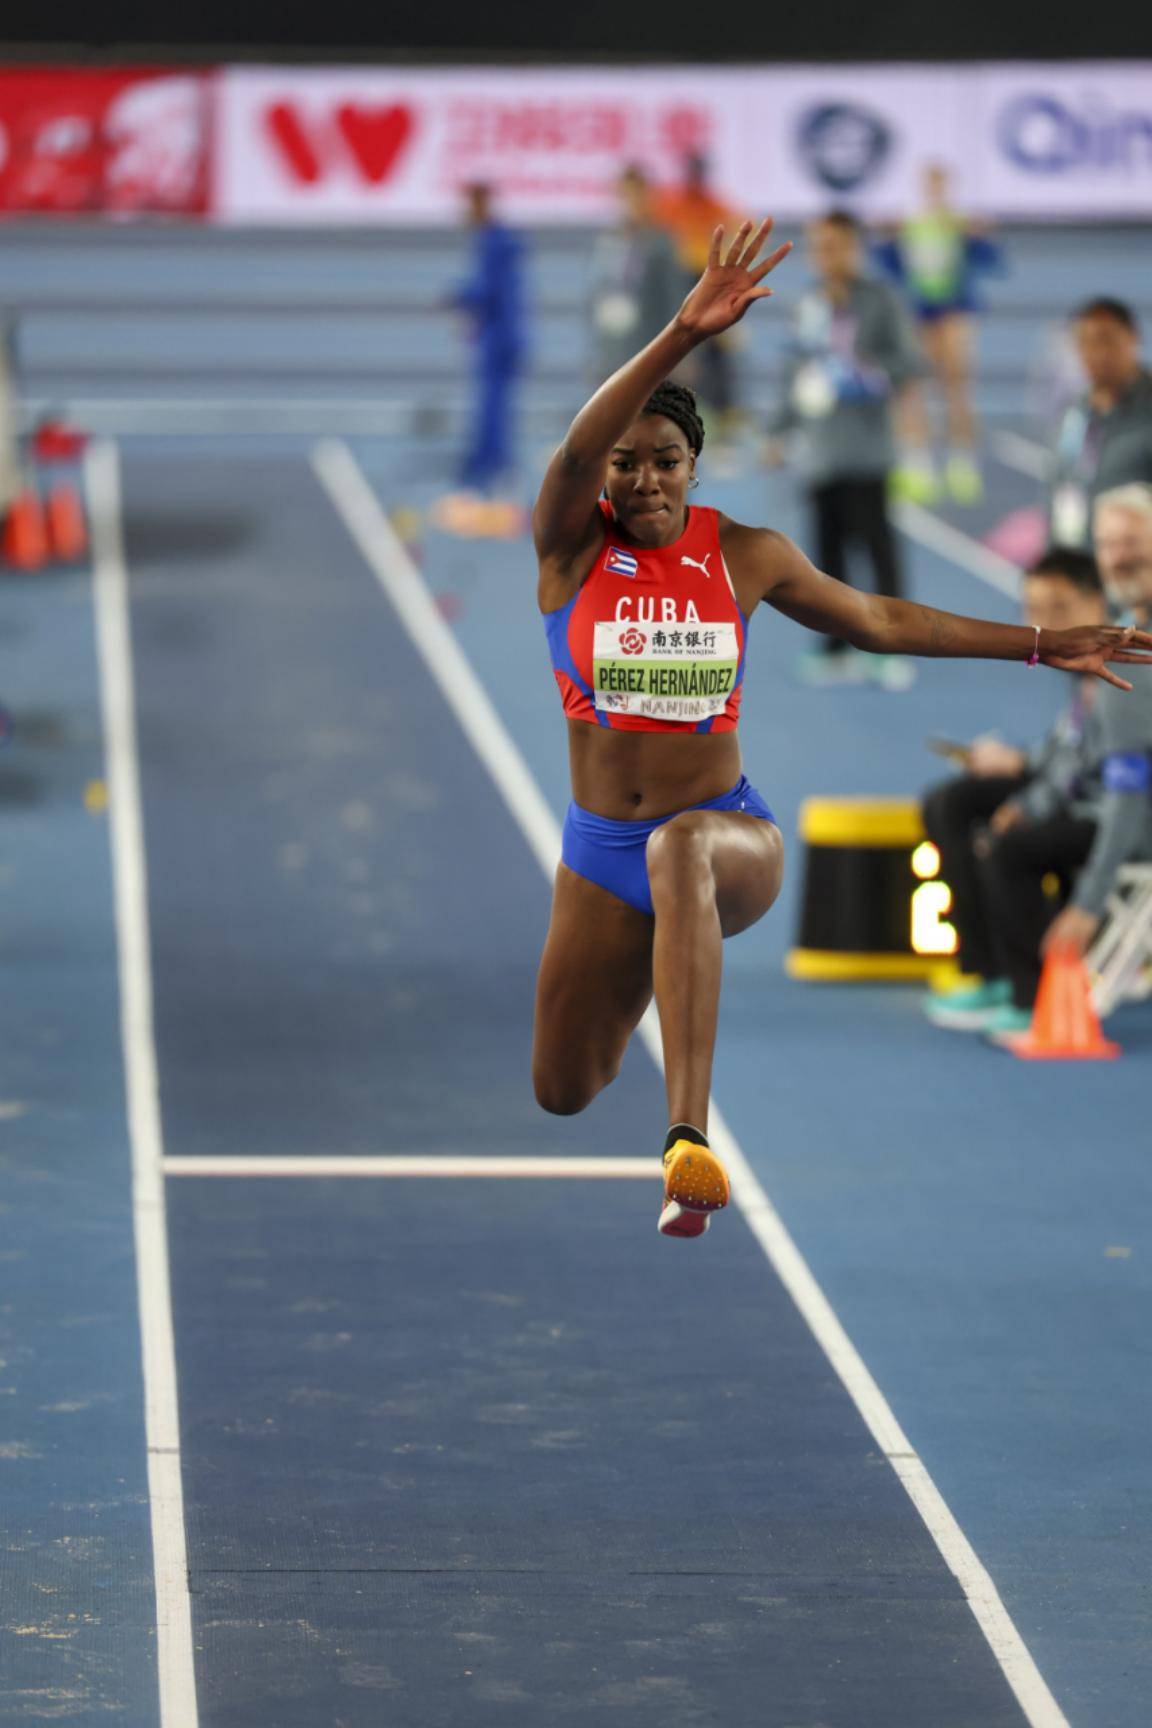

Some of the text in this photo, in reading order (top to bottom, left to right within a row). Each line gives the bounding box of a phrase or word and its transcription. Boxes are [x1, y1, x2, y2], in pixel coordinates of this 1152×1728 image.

[615, 596, 701, 623] CUBA
[652, 630, 716, 648] 南京银行
[600, 661, 733, 696] PÉREZ HERNÁNDEZ
